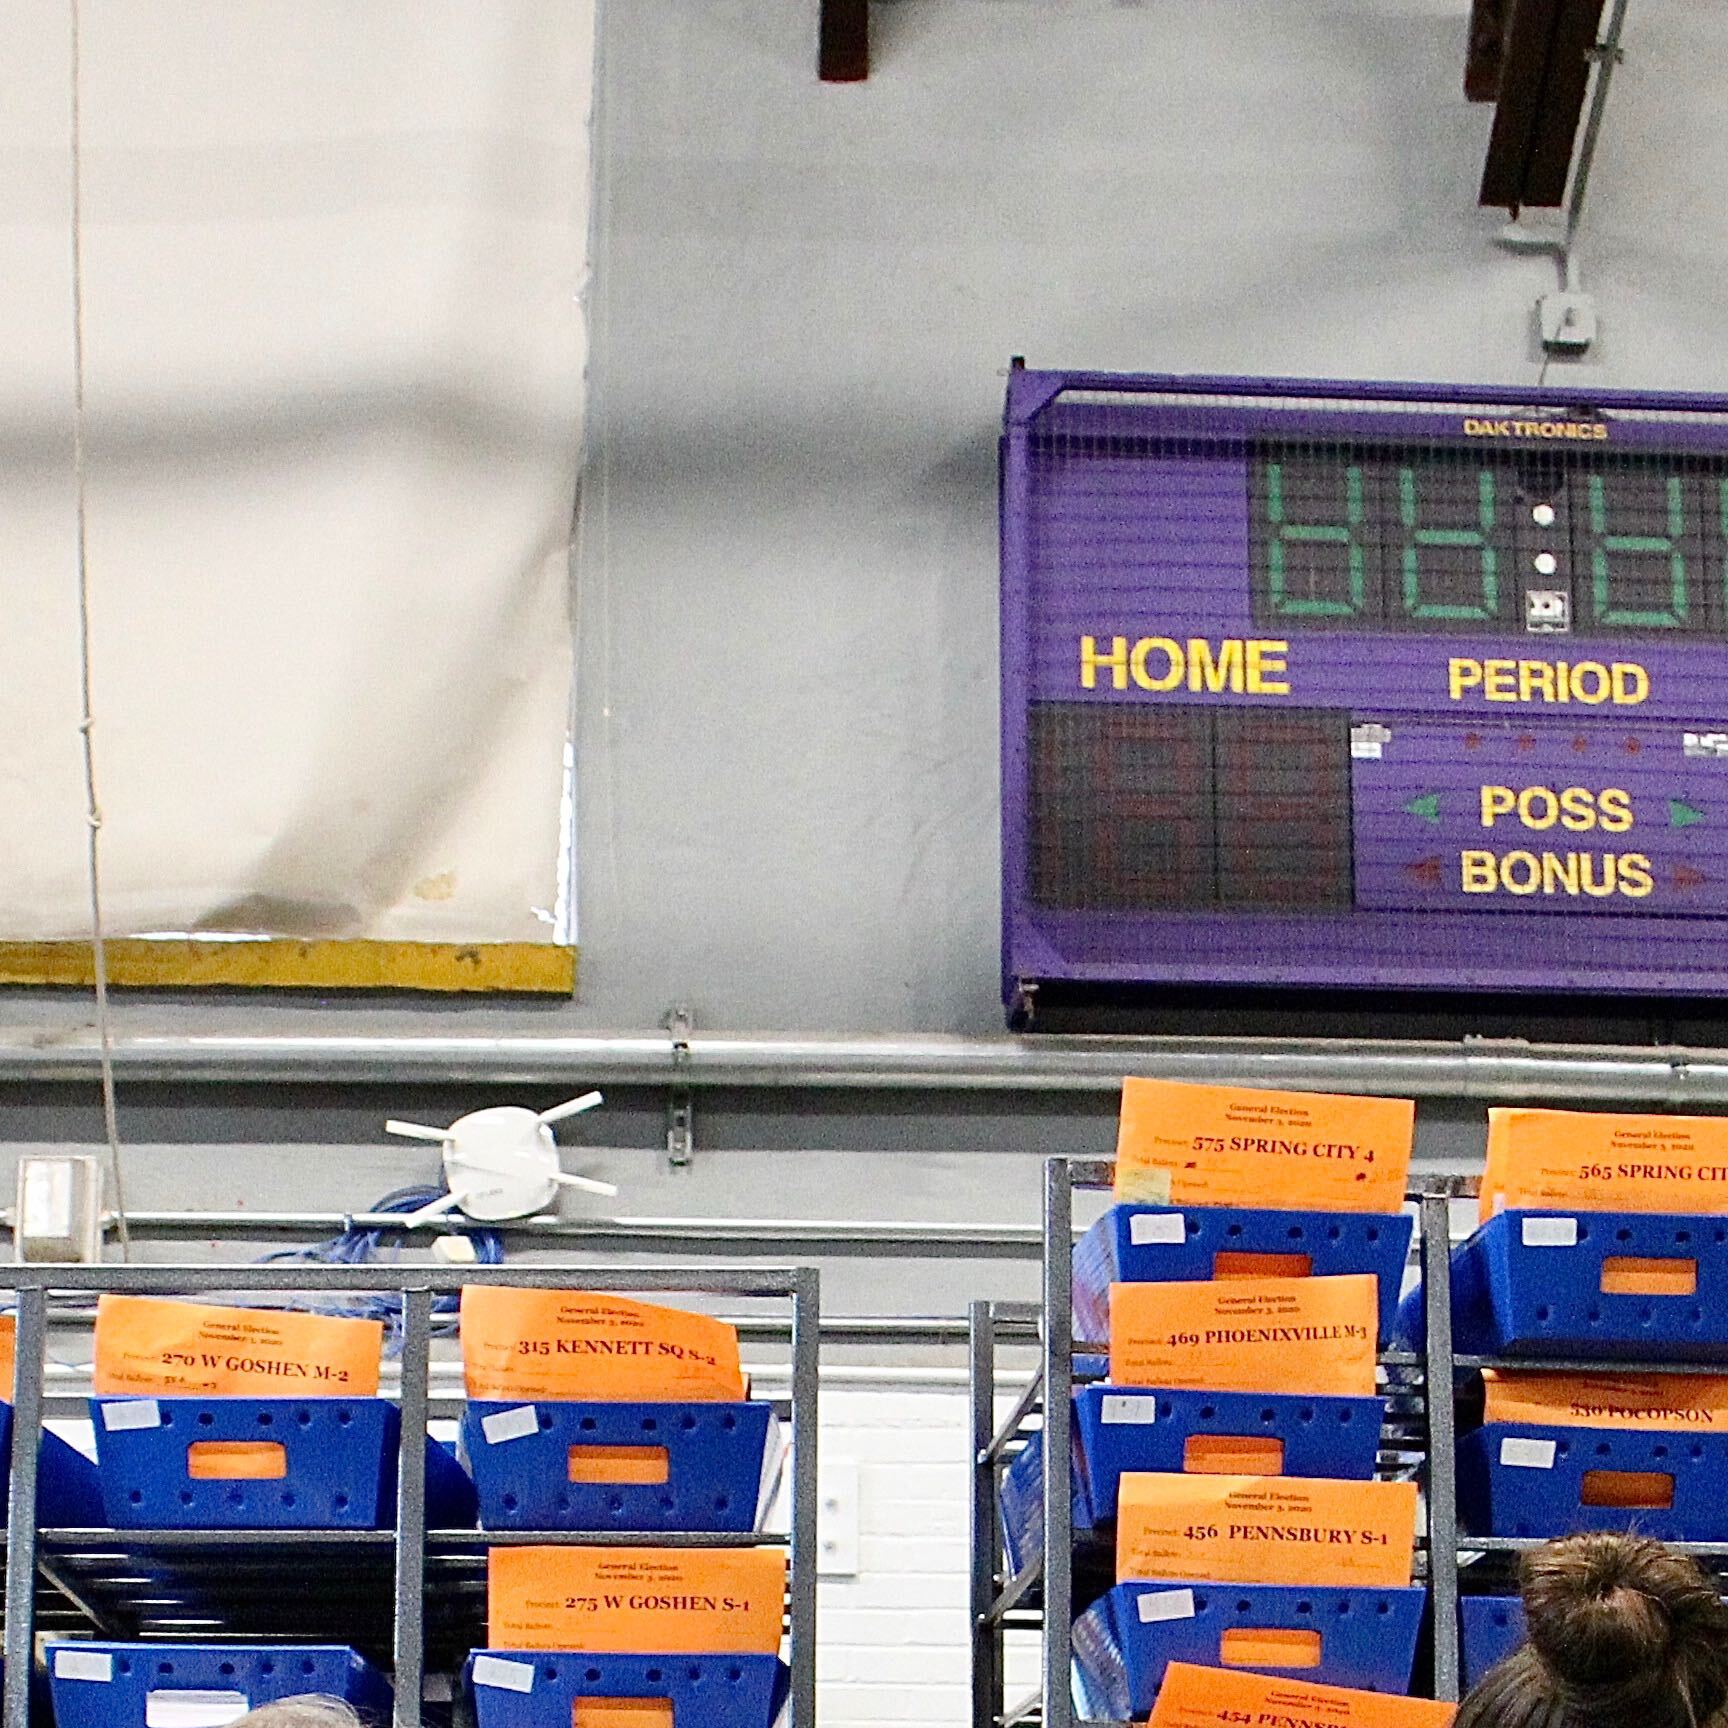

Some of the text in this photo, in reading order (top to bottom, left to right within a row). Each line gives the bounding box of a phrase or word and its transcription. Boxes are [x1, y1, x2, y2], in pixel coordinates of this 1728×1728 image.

[1463, 419, 1607, 439] DAKTRONICS
[1079, 636, 1290, 695] HOME
[1448, 658, 1650, 704] PERIOD
[1480, 786, 1633, 831] POSS
[1461, 849, 1654, 897] BONUS
[1230, 1103, 1309, 1116] General Election
[1615, 1130, 1690, 1139] General Election
[1192, 1136, 1224, 1152] 575
[1231, 1136, 1307, 1156] SPRING
[1313, 1144, 1360, 1159] CITY
[1364, 1150, 1374, 1162] 4
[1578, 1164, 1611, 1179] 565
[1618, 1164, 1692, 1179] SPRING
[1218, 1295, 1296, 1304] General Election
[560, 1306, 640, 1318] General Election
[1167, 1324, 1366, 1347] 469 PHOENIXVILLE M-3
[518, 1340, 550, 1355] 315
[556, 1340, 653, 1355] KENNETT
[658, 1342, 684, 1360] SQ
[688, 1350, 716, 1366] S-2
[162, 1353, 348, 1382] 270 W GOSHEN M-2
[1608, 1404, 1713, 1422] POCOPSON
[1229, 1491, 1309, 1502] General Election
[1184, 1526, 1218, 1540] 456
[1229, 1525, 1356, 1544] PENNSBURY
[1361, 1531, 1387, 1545] S-1
[598, 1562, 678, 1571] General Election
[565, 1597, 598, 1612] 275
[604, 1595, 624, 1609] W
[630, 1596, 716, 1610] GOSHEN
[722, 1598, 748, 1612] S-1
[1217, 1710, 1251, 1724] 454
